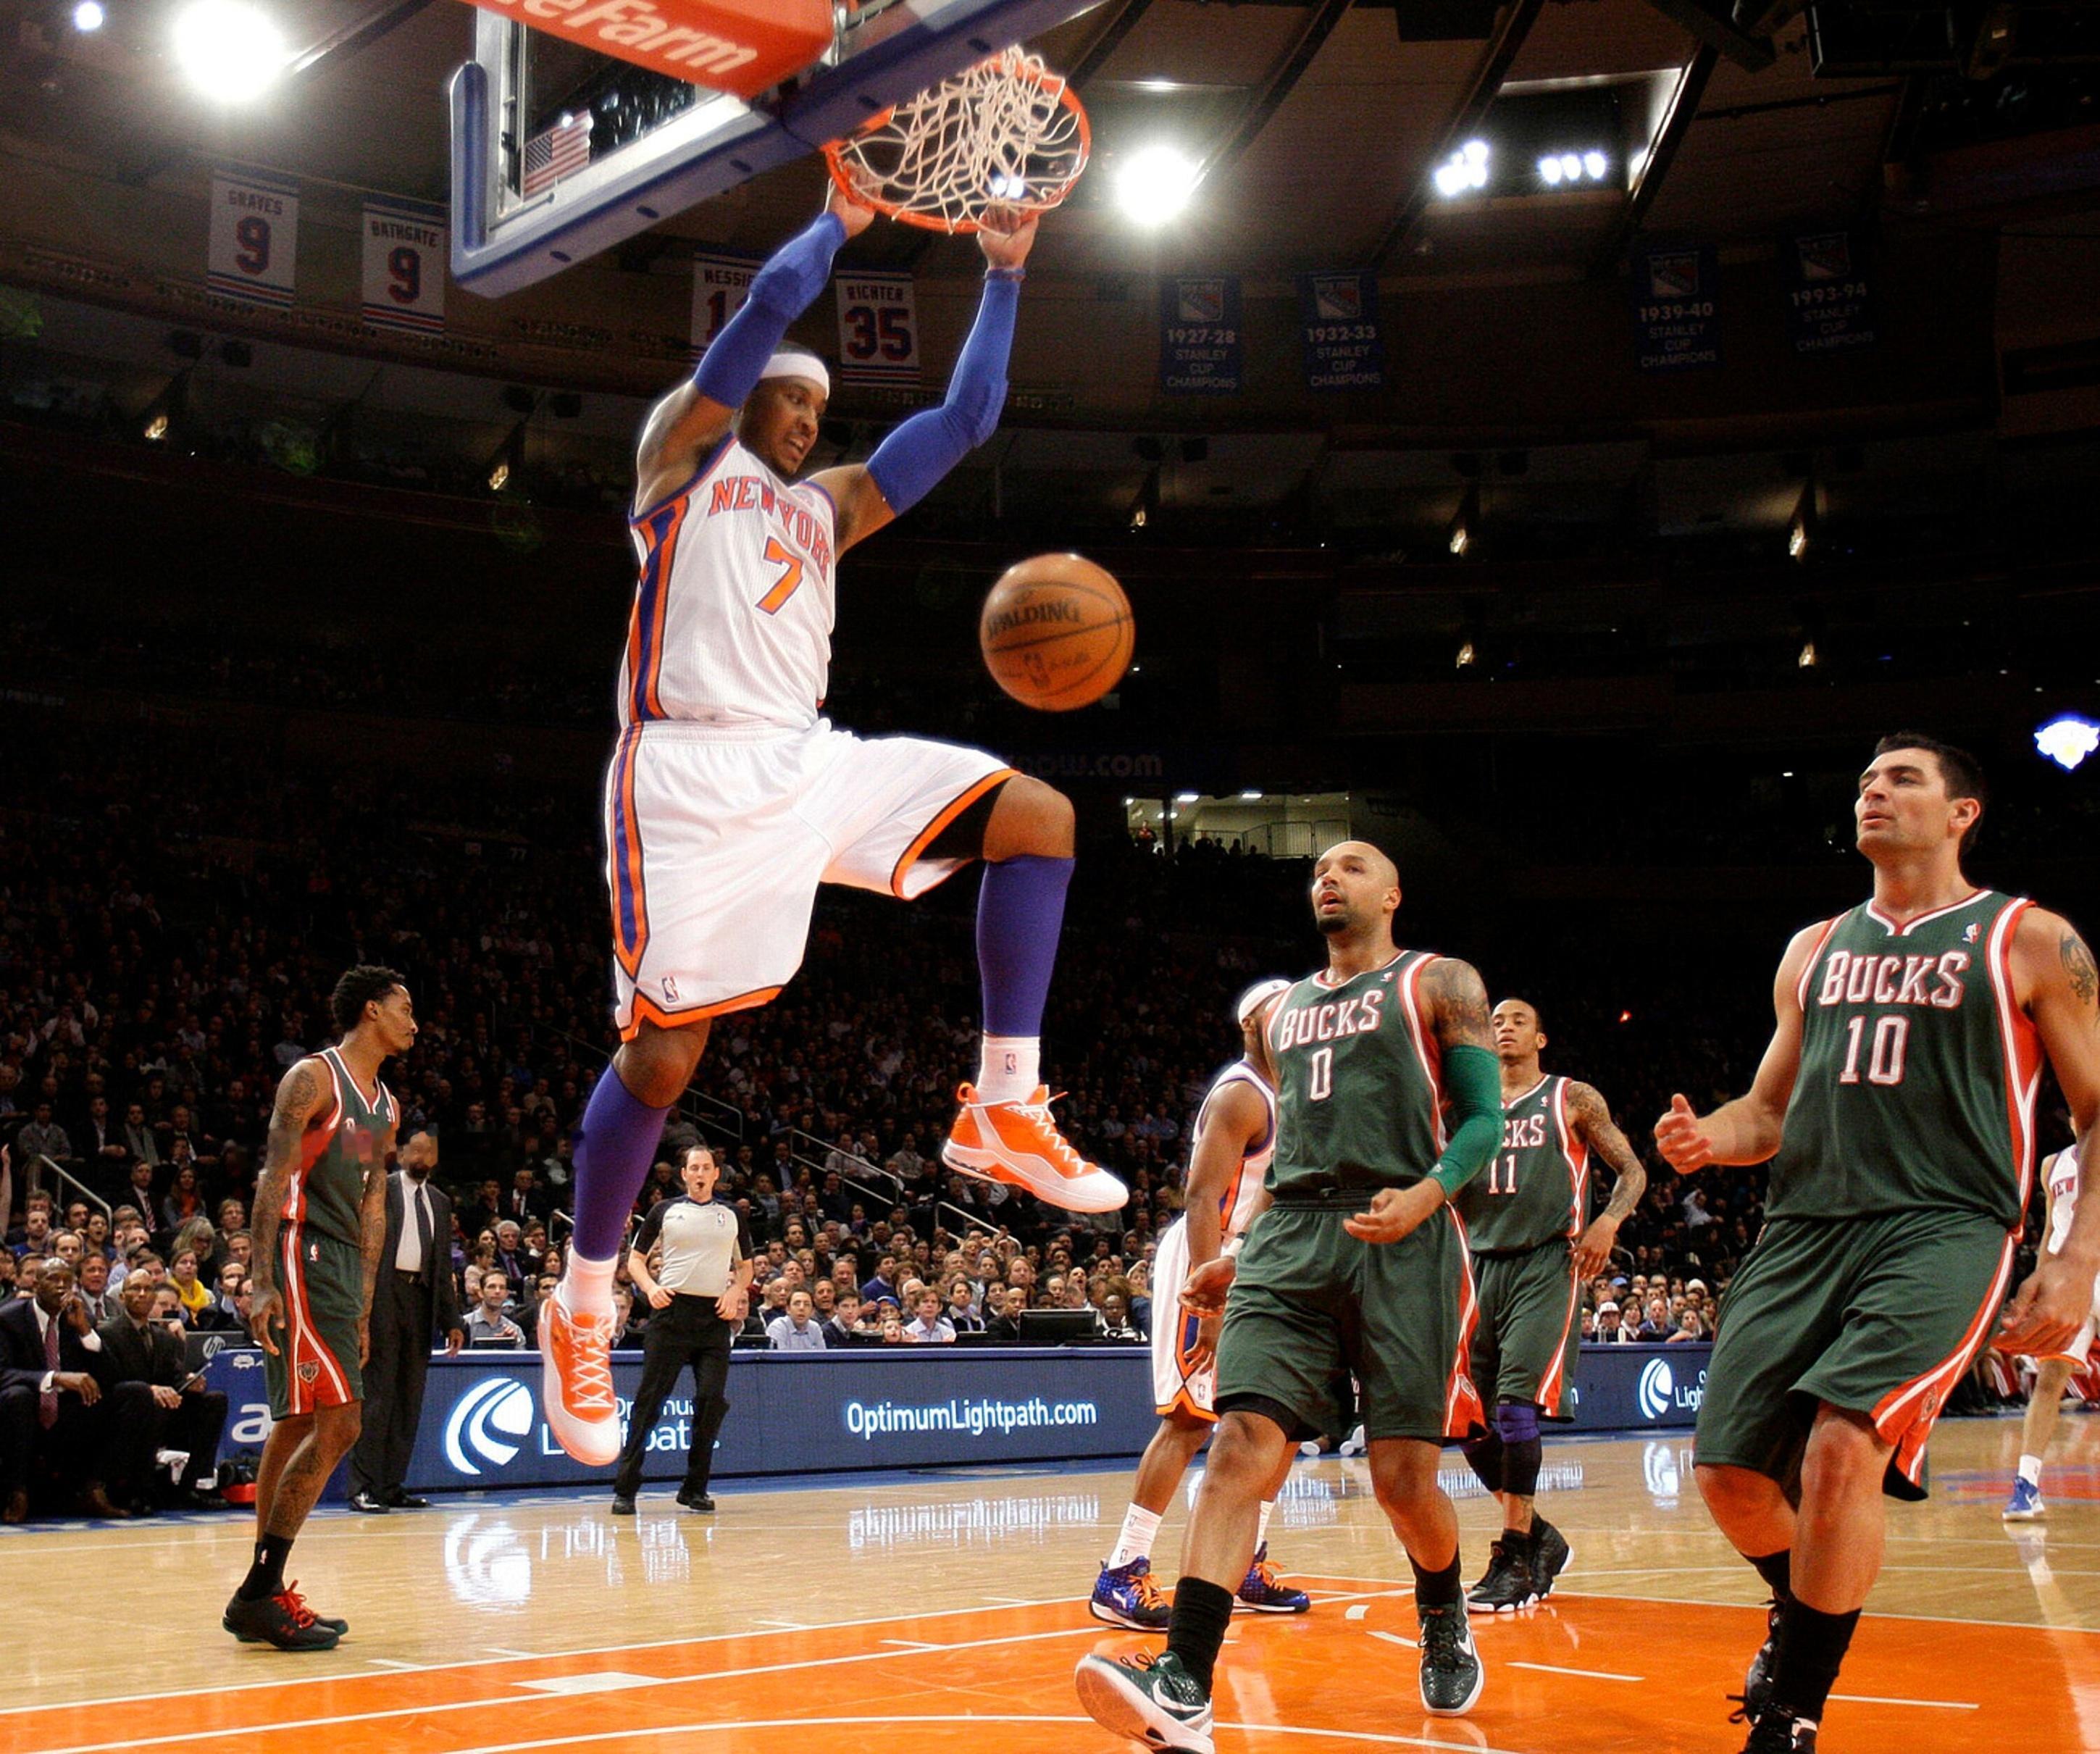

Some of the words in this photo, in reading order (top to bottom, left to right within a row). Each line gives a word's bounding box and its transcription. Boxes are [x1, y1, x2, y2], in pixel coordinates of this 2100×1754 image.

[495, 0, 758, 73] eFarm
[371, 220, 438, 247] BATHGATE
[236, 215, 272, 276] 9
[388, 246, 421, 304] 9
[848, 285, 903, 301] RICHTER
[1791, 283, 1867, 306] 1993-94
[706, 291, 750, 343] 1
[1639, 301, 1713, 322] 1939-40
[1802, 304, 1860, 322] STANLEY
[844, 306, 912, 361] 35
[1167, 328, 1236, 344] 1927-28
[1307, 325, 1376, 343] 1932-33
[1649, 323, 1704, 339] STANLEY
[1820, 321, 1847, 335] CUP
[1316, 345, 1370, 359] STANLEY
[1665, 339, 1691, 351] CUP
[1796, 330, 1874, 352] CHAMPIONS
[1175, 348, 1229, 360] STANLEY
[1640, 350, 1716, 368] CHAMPIONS
[1189, 364, 1214, 375] CUP
[1331, 361, 1357, 372] CUP
[1166, 376, 1237, 389] CHAMPIONS
[1310, 373, 1381, 387] CHAMPIONS
[708, 476, 776, 517] NEW
[756, 536, 803, 615] 7
[1817, 950, 1971, 1008] BUCKS
[1279, 990, 1384, 1051] BUCKS
[1838, 1014, 1909, 1085] 10
[1310, 1047, 1333, 1101] 0
[1488, 1153, 1518, 1194] 11
[847, 1398, 1097, 1440] OptimumLightpath.com
